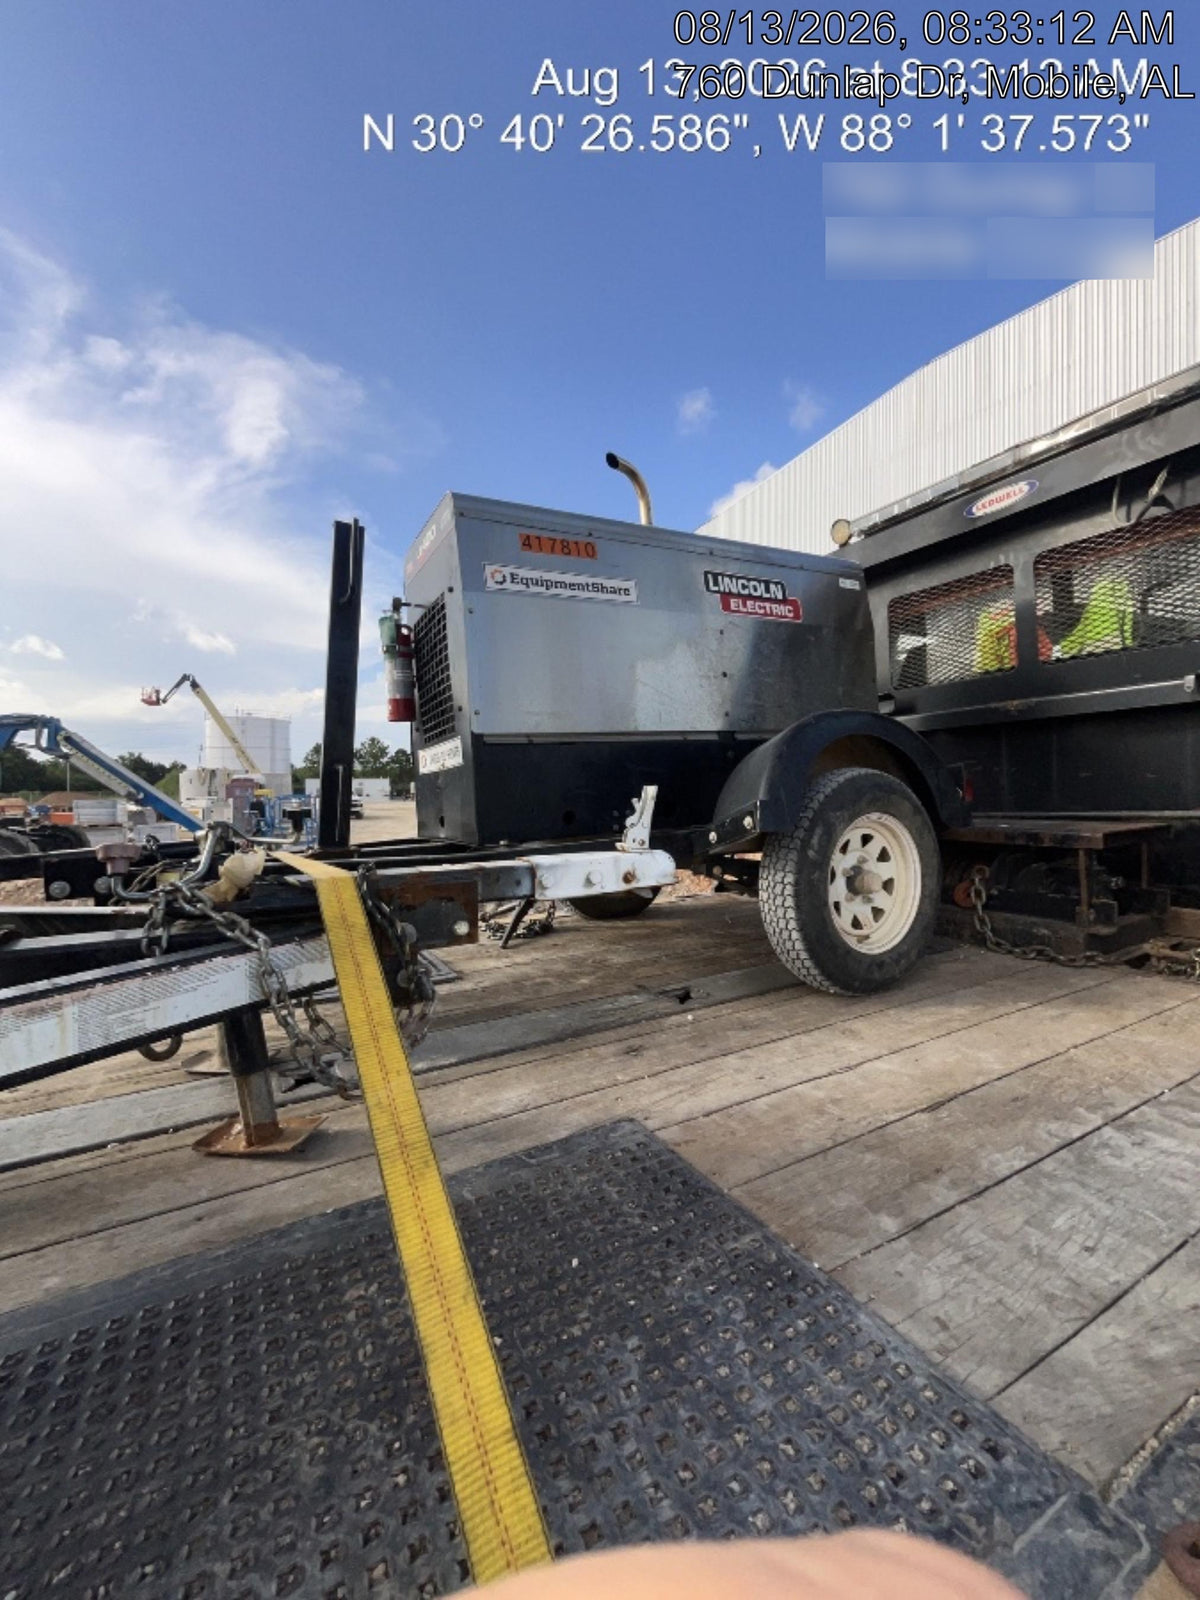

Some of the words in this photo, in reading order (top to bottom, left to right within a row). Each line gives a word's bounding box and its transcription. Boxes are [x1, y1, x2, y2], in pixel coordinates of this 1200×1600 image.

[521, 534, 596, 558] 417810
[509, 571, 632, 597] EquipmentShare
[707, 573, 784, 600] LINCOLN
[729, 598, 795, 618] ELECTRIC
